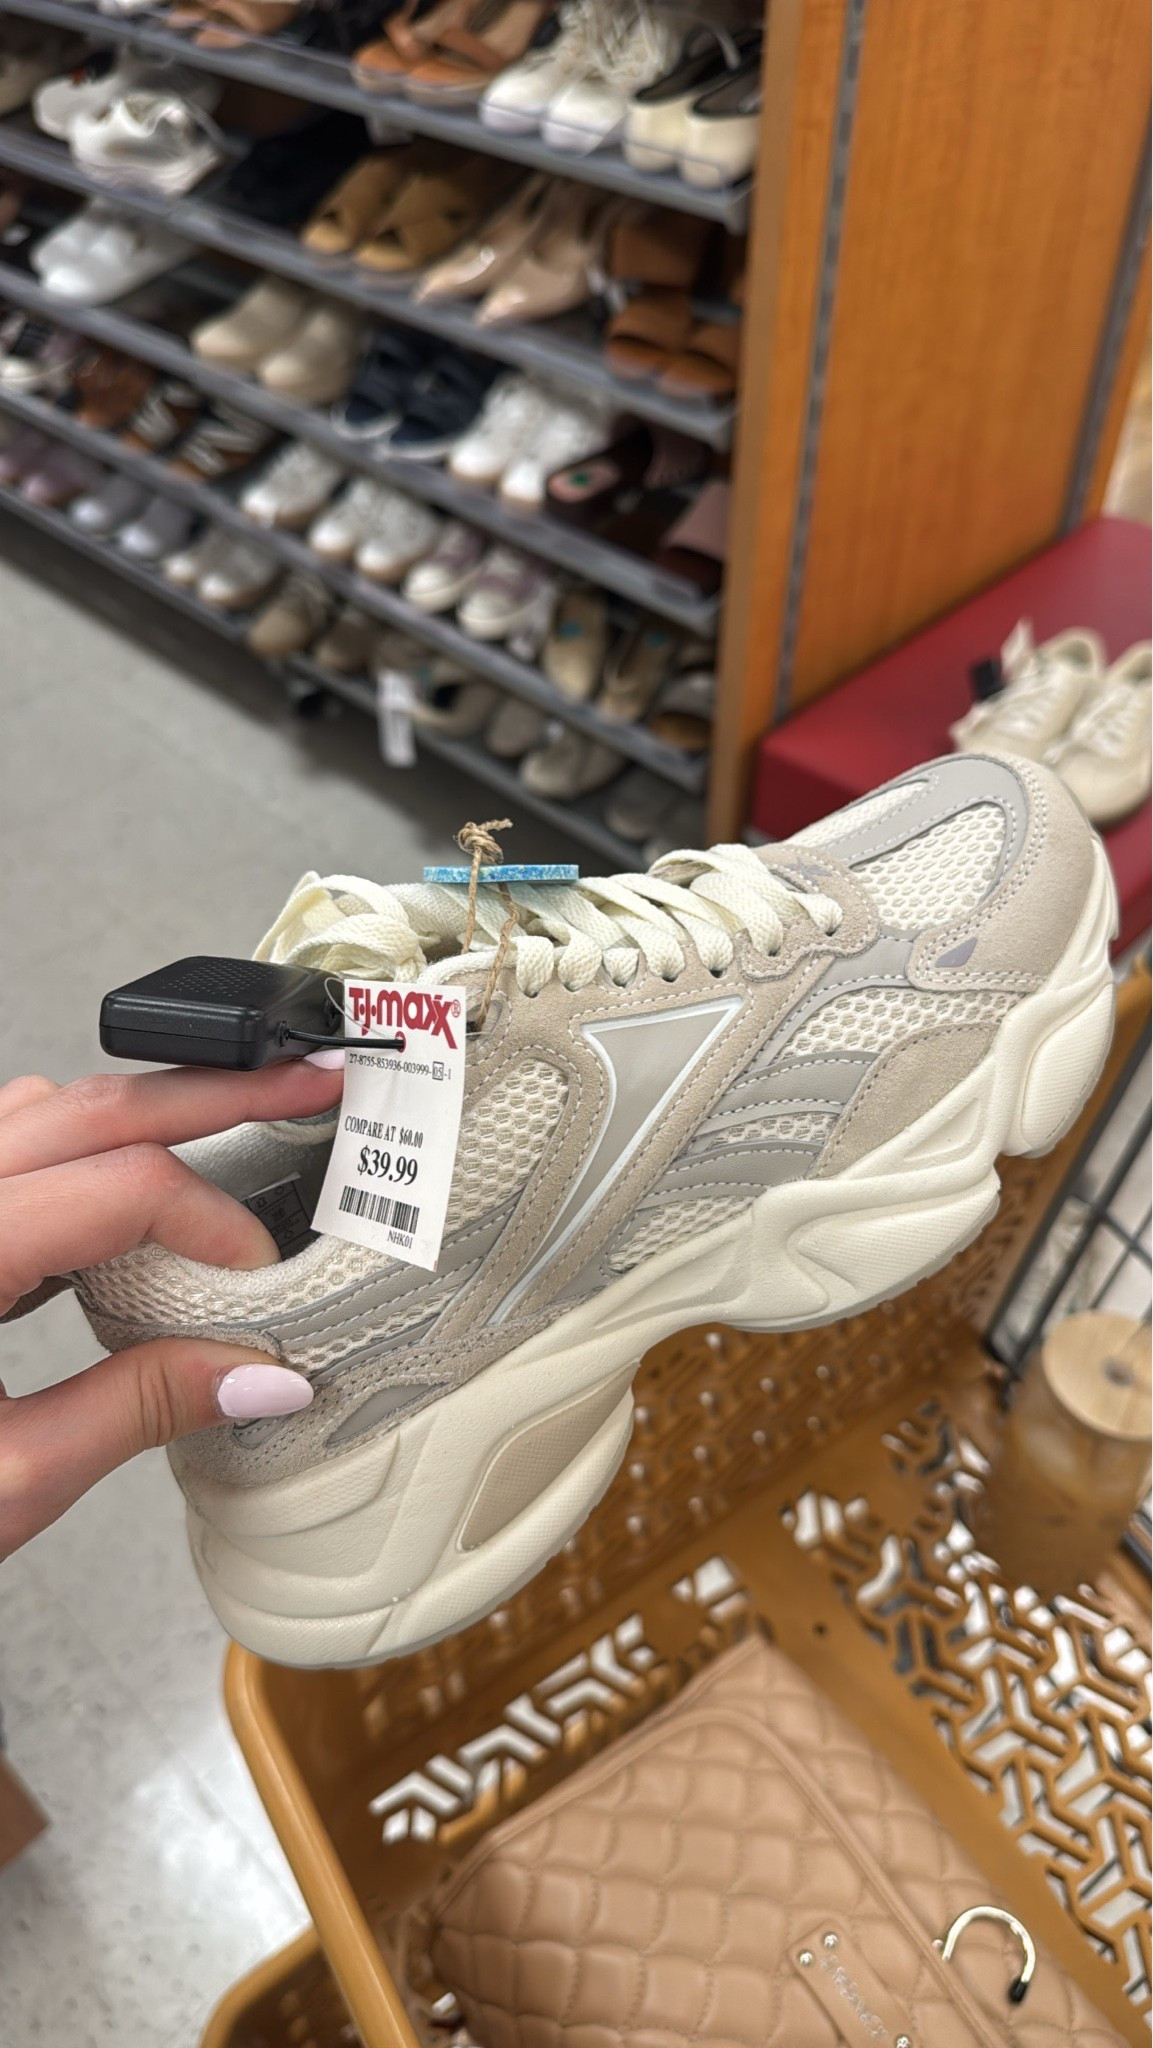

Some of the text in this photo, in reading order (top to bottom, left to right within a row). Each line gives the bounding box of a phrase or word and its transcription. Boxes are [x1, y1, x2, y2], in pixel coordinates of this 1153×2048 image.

[345, 1115, 424, 1149] COMPARE AT $60.00
[357, 1145, 418, 1186] $39.99
[387, 1230, 413, 1249] NHK01
